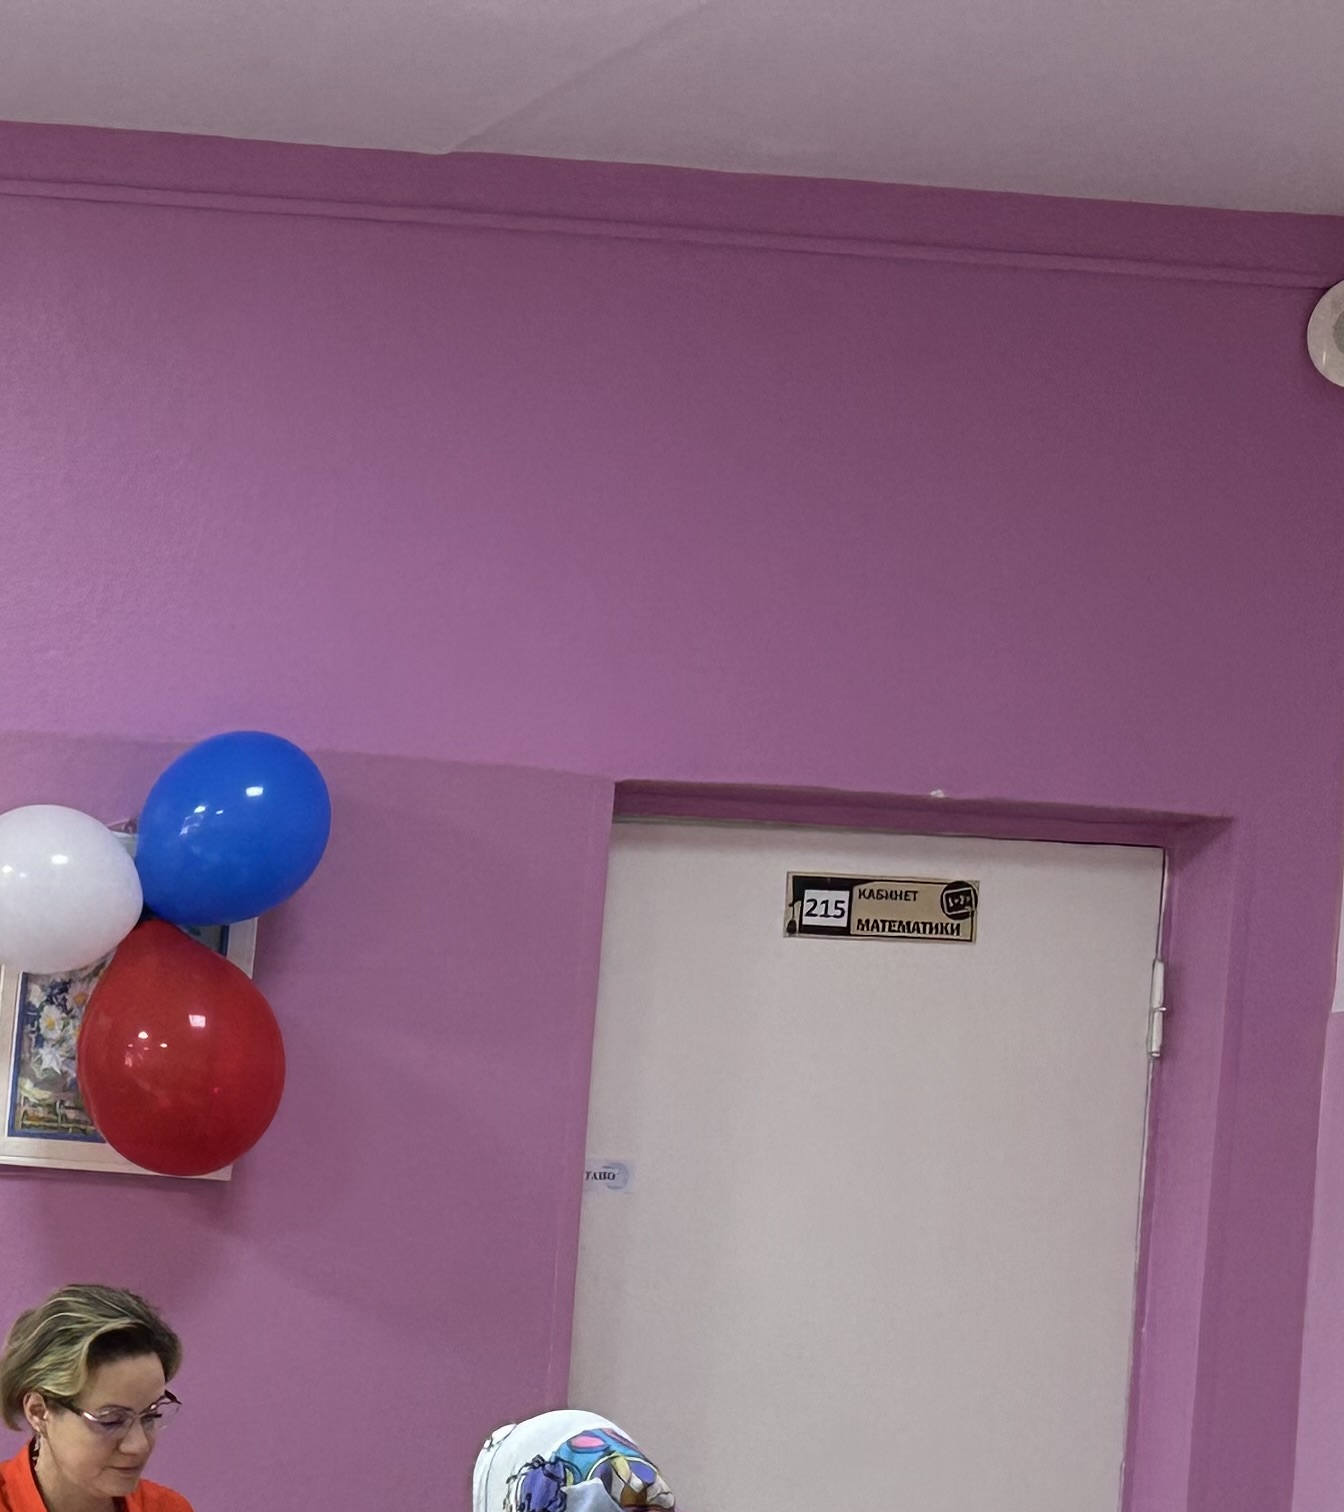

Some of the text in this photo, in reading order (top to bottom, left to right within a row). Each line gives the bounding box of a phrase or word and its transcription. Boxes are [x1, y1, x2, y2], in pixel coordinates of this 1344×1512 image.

[858, 888, 920, 902] КАБИНЕТ
[804, 898, 846, 919] 215
[856, 918, 961, 937] МАТЕМАТИКИ
